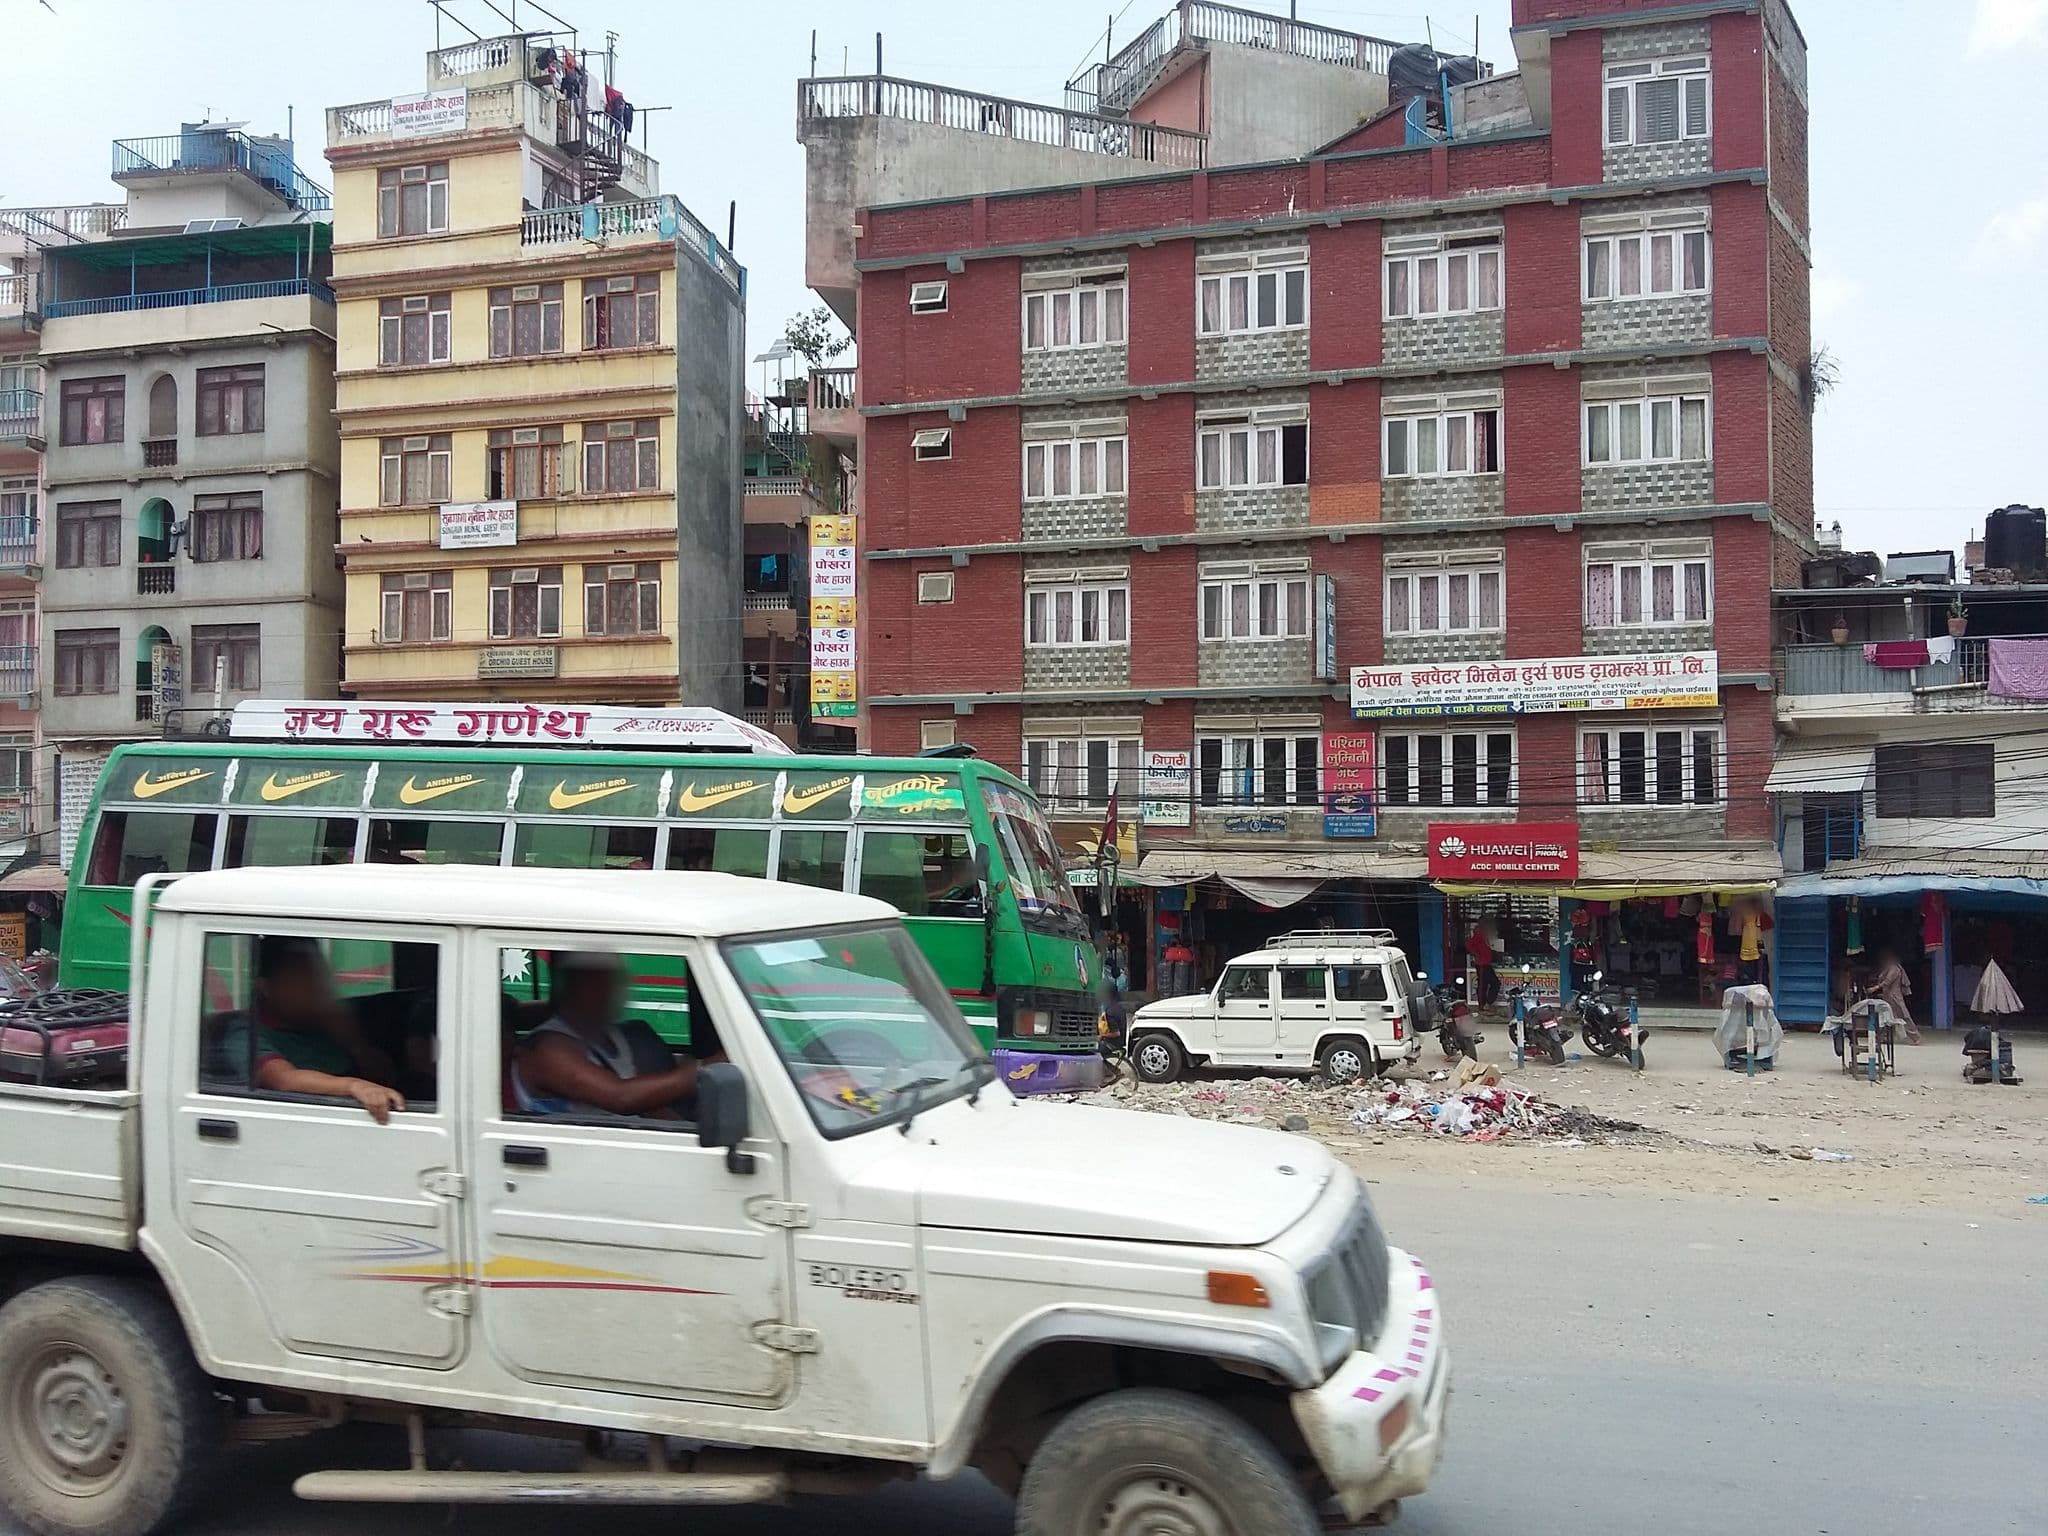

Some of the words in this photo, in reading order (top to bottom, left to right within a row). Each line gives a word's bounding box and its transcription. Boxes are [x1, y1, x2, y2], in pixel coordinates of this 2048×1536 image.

[815, 558, 852, 570] पोखरा
[831, 575, 852, 585] हाउस
[813, 641, 850, 653] पोखरा
[488, 658, 510, 666] ORCHID
[512, 658, 531, 666] GUEST
[532, 657, 552, 665] HOUSE
[1356, 670, 1402, 688] नेपाल
[1466, 664, 1517, 683] भिलेज
[1522, 662, 1548, 685] टुर्स
[1552, 664, 1584, 680] एण्ड
[1590, 662, 1648, 683] ट्राभल्स
[1653, 660, 1676, 676] प्रा.
[1682, 656, 1708, 674] लि.
[1632, 697, 1665, 707] DHL
[1445, 706, 1451, 714] र
[285, 708, 347, 735] जय
[453, 705, 592, 739] गणेश
[1330, 736, 1367, 749] पश्चिम
[1326, 750, 1369, 766] लुम्बिनी
[284, 774, 312, 786] ANISH
[312, 770, 332, 780] BRO
[426, 777, 452, 788] ANISH
[454, 774, 473, 784] BRO
[578, 782, 608, 793] ANISH
[608, 778, 627, 788] BRO
[704, 784, 733, 796] ANISH
[734, 780, 754, 790] BRO
[801, 784, 830, 797] ANISH
[831, 776, 850, 788] BRO
[864, 774, 948, 804] नुवाकोटे
[1470, 844, 1528, 856] HUAWEI
[810, 1265, 907, 1291] BOLERO
